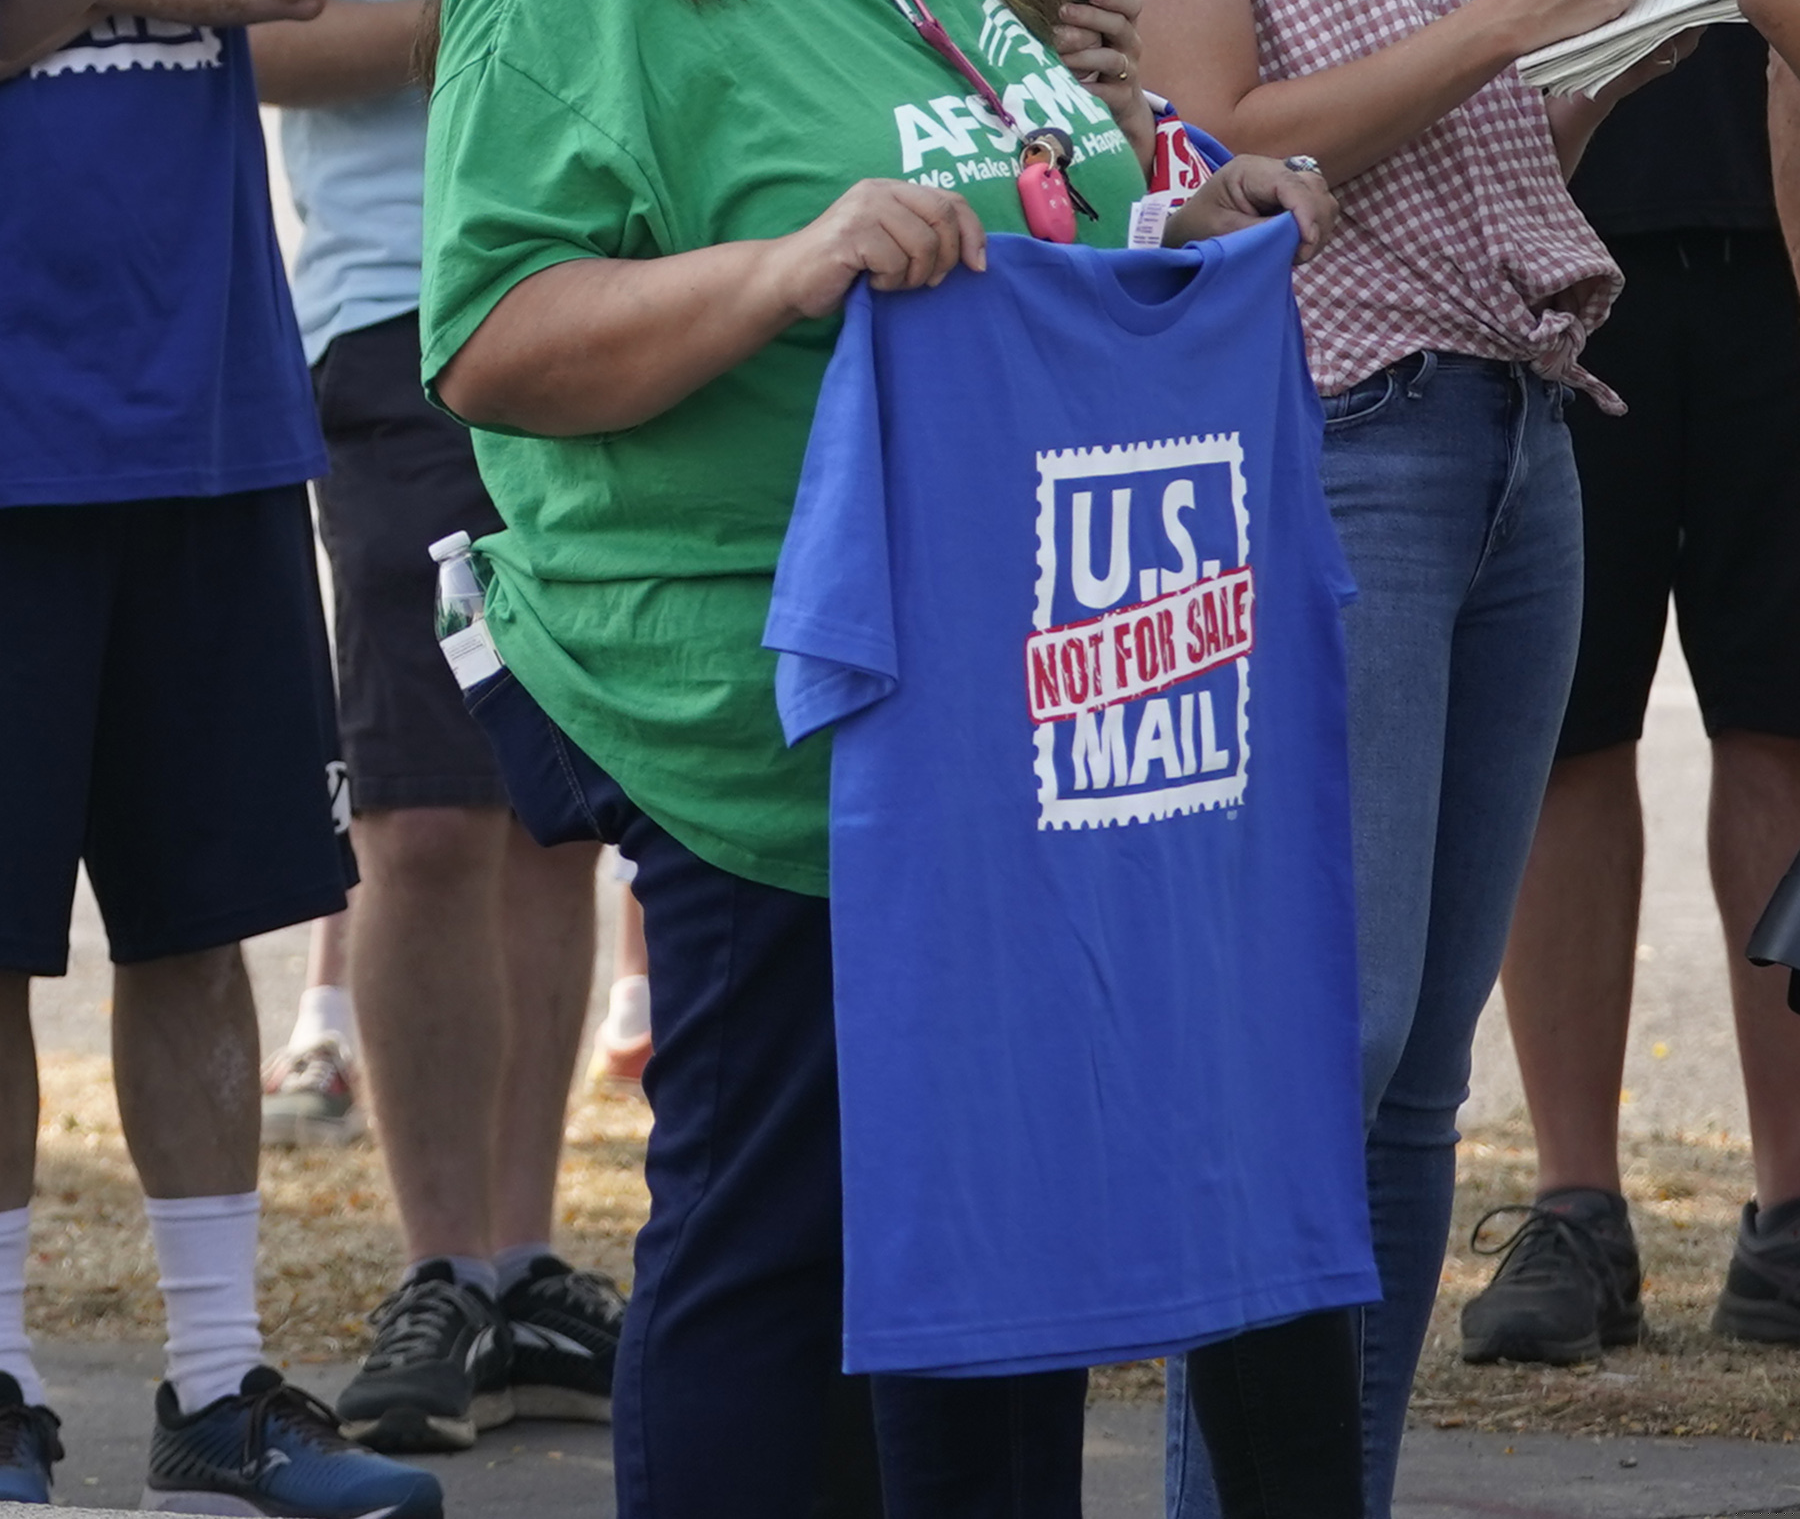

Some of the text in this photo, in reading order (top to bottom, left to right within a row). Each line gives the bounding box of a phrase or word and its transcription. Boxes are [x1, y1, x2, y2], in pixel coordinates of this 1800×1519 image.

[894, 65, 1112, 173] AFSCME
[908, 169, 956, 189] We
[956, 157, 1010, 183] Make
[1071, 479, 1220, 609] U.S.
[1031, 580, 1249, 710] NOT FOR SALE
[1072, 690, 1229, 791] MAIL
